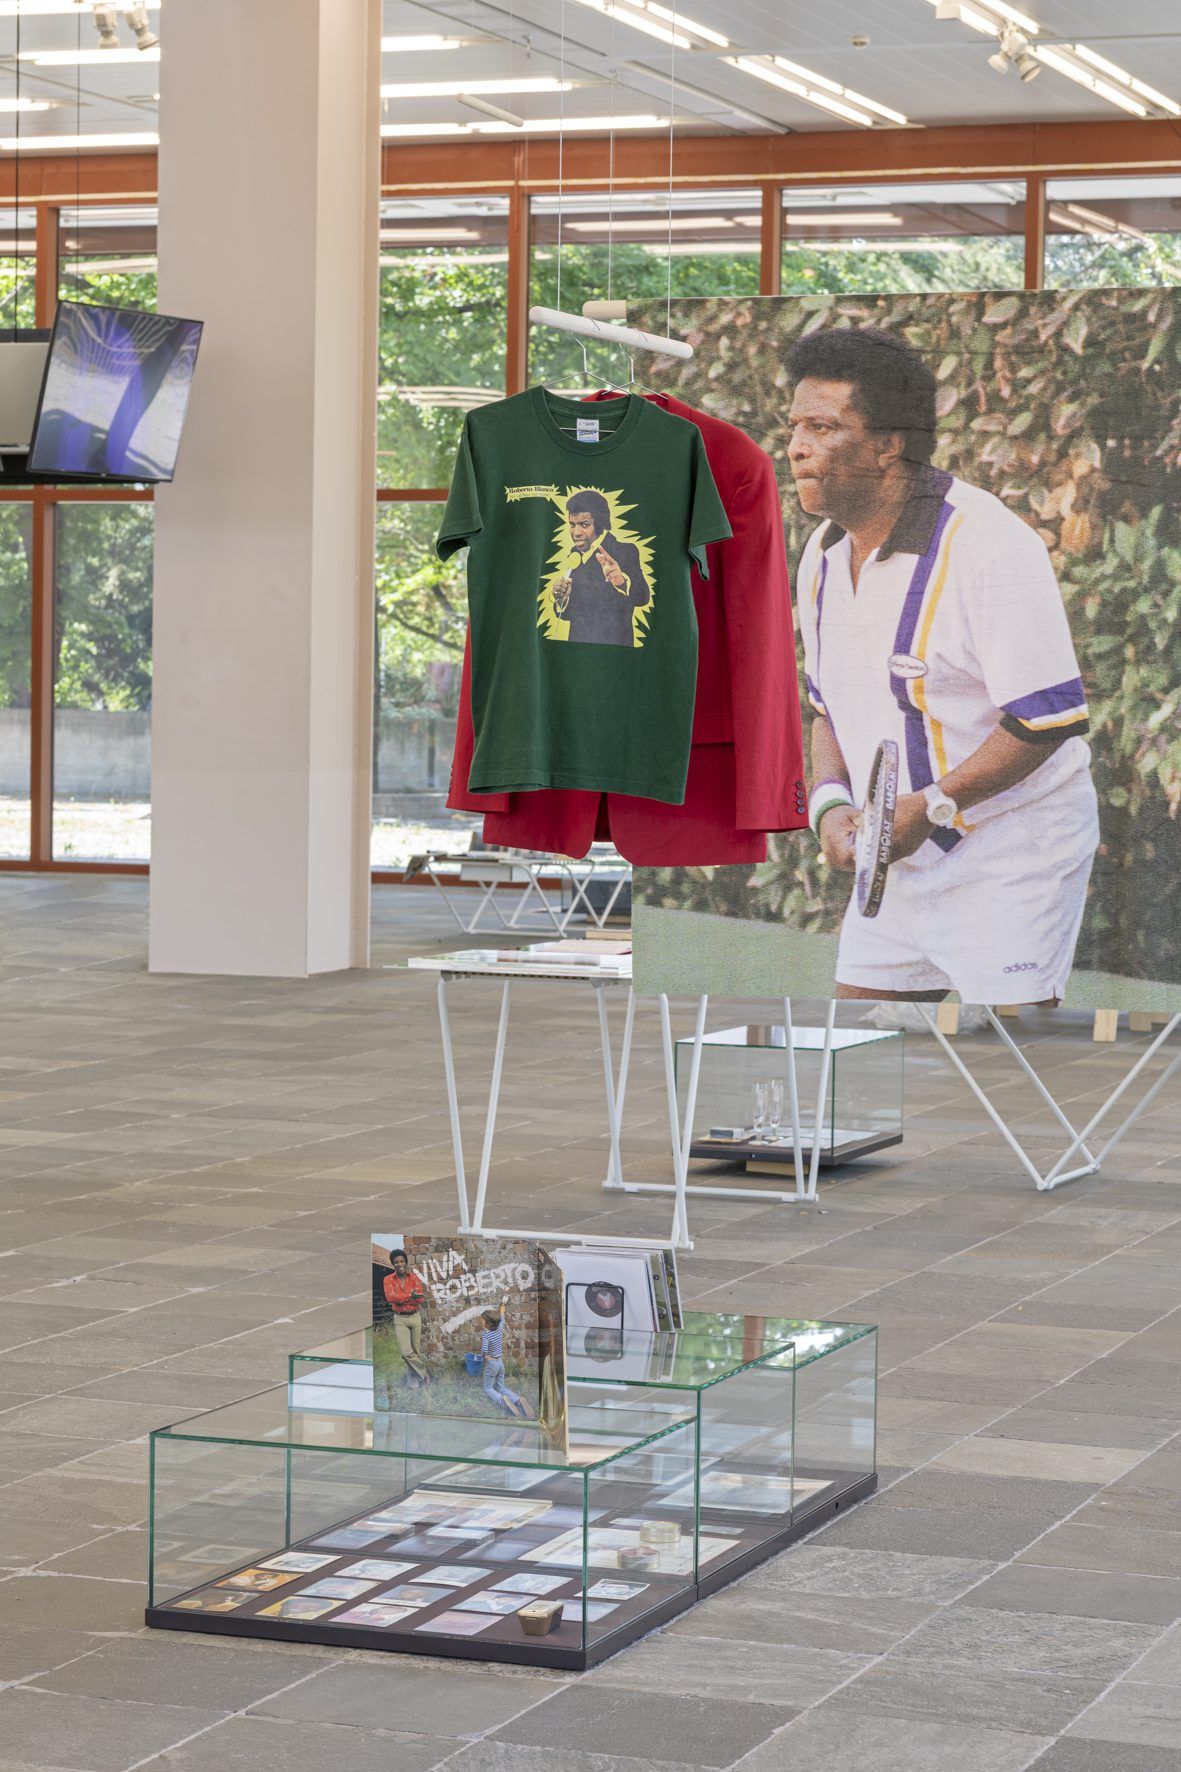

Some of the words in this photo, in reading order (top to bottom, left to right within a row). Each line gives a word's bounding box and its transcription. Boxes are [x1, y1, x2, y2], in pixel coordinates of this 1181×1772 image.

[879, 820, 893, 864] BABOLAT
[1002, 962, 1039, 974] adidas
[412, 1248, 469, 1290] VIVA
[431, 1262, 535, 1304] ROBERTO
